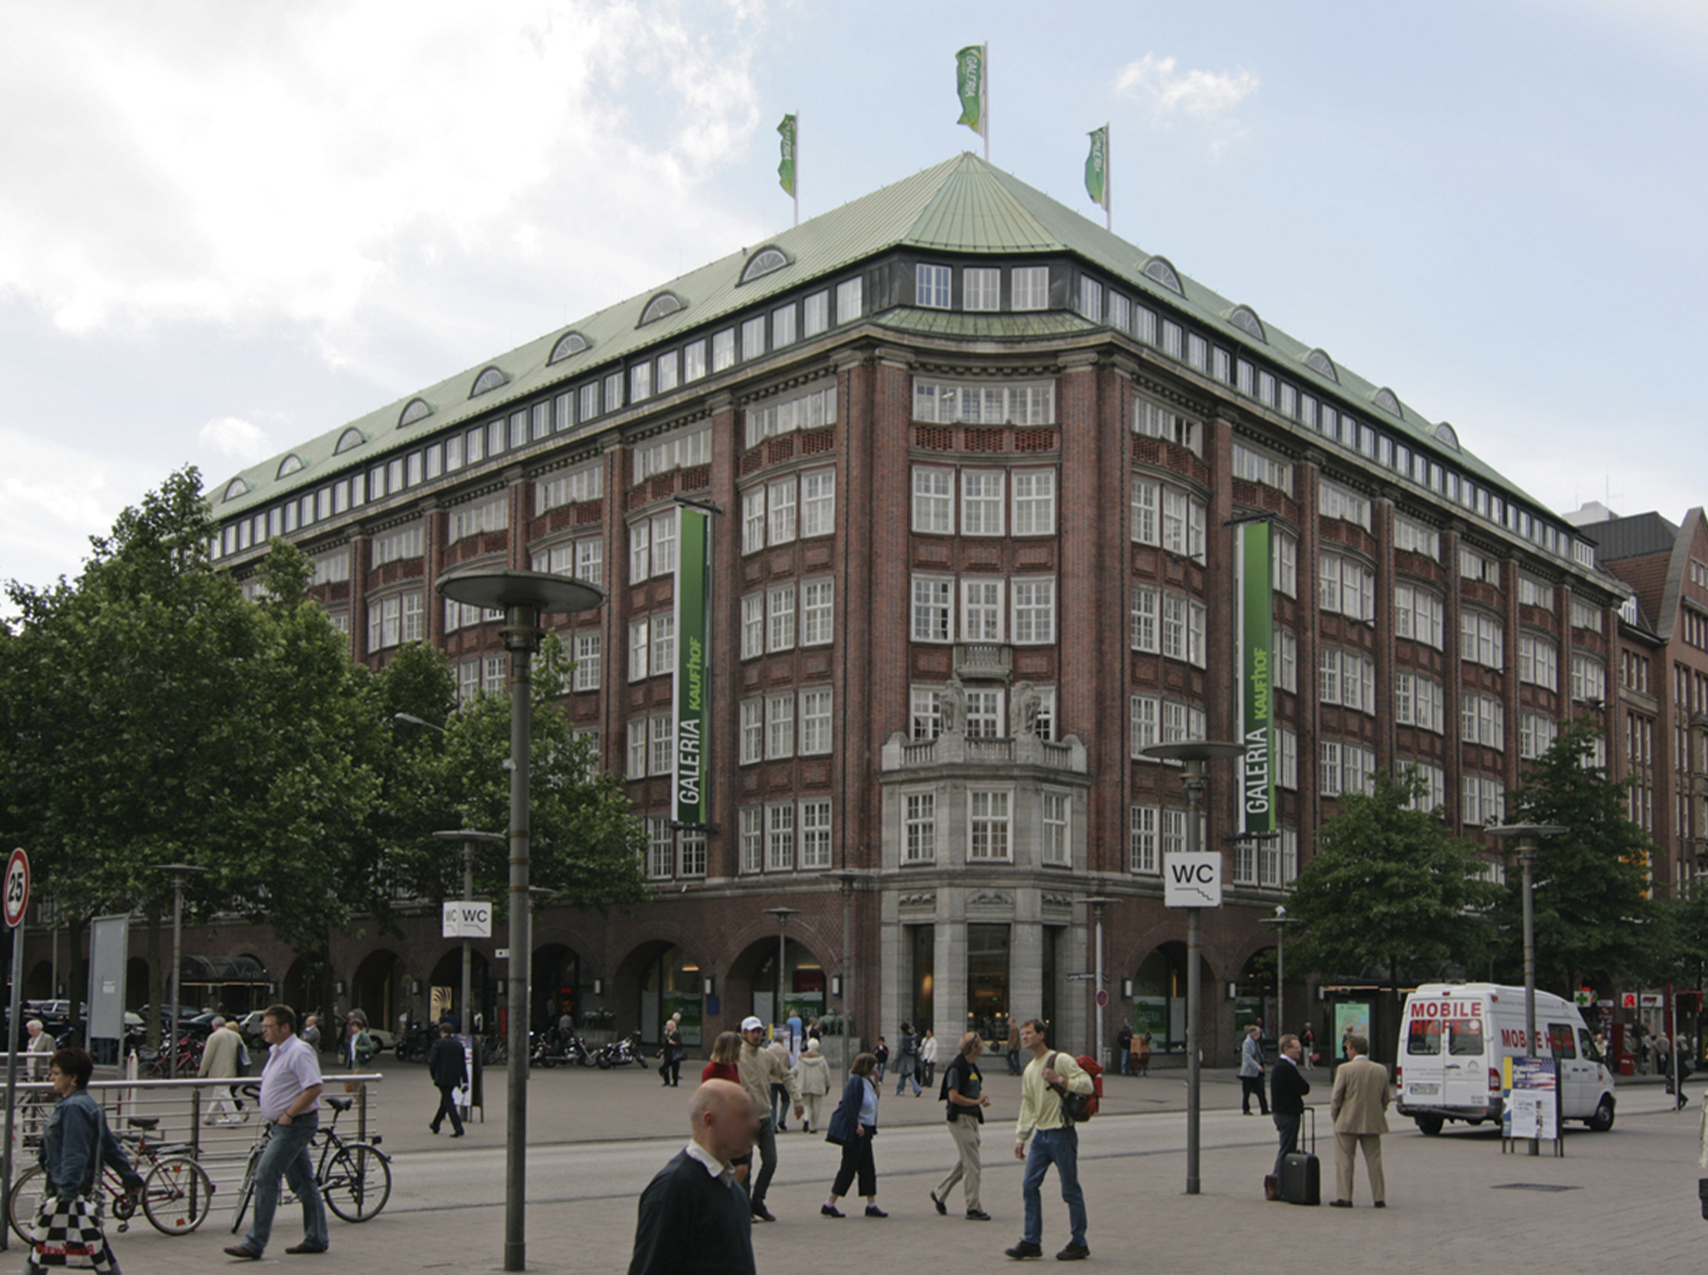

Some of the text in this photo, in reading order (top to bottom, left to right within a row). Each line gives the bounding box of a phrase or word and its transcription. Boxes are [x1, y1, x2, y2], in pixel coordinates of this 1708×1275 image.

[679, 719, 700, 805] GALERIA
[1246, 726, 1269, 814] GALERIA
[1172, 863, 1213, 883] WC
[8, 872, 23, 903] 25
[462, 909, 488, 923] WC
[1411, 1002, 1482, 1017] MOBILE
[1411, 1019, 1464, 1035] HILFE
[1501, 1029, 1543, 1048] MOBE
